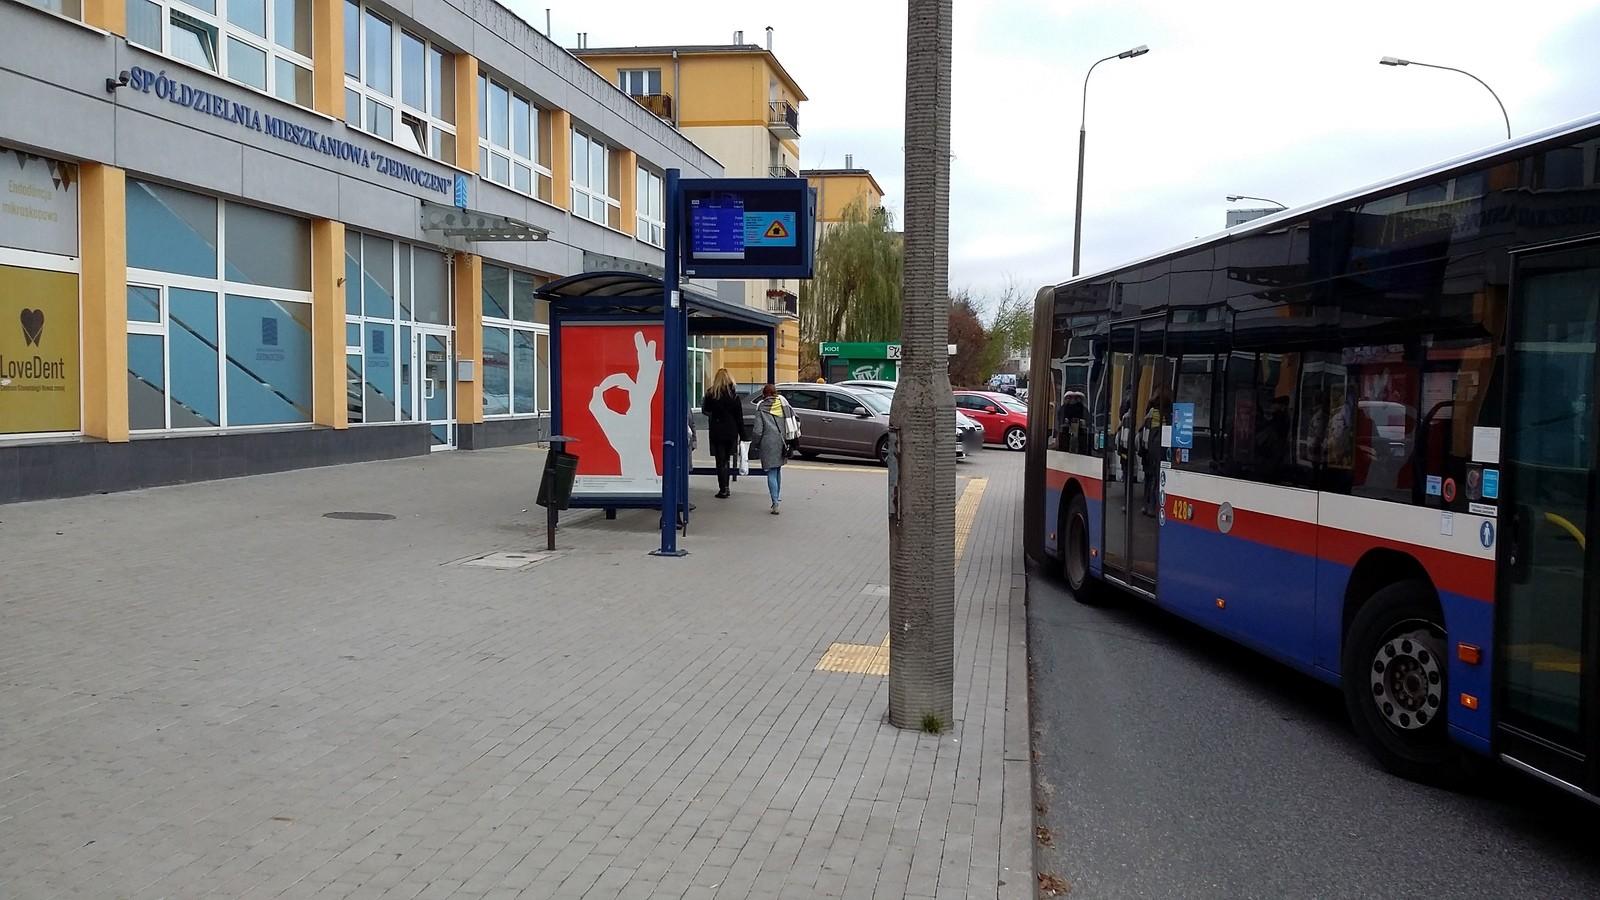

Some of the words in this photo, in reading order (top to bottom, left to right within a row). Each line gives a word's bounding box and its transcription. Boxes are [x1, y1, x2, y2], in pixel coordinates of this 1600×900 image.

[130, 66, 262, 132] SPÓŁDZIELNIA
[264, 114, 370, 168] MIESZKANIOWA
[0, 354, 65, 379] LoveDent
